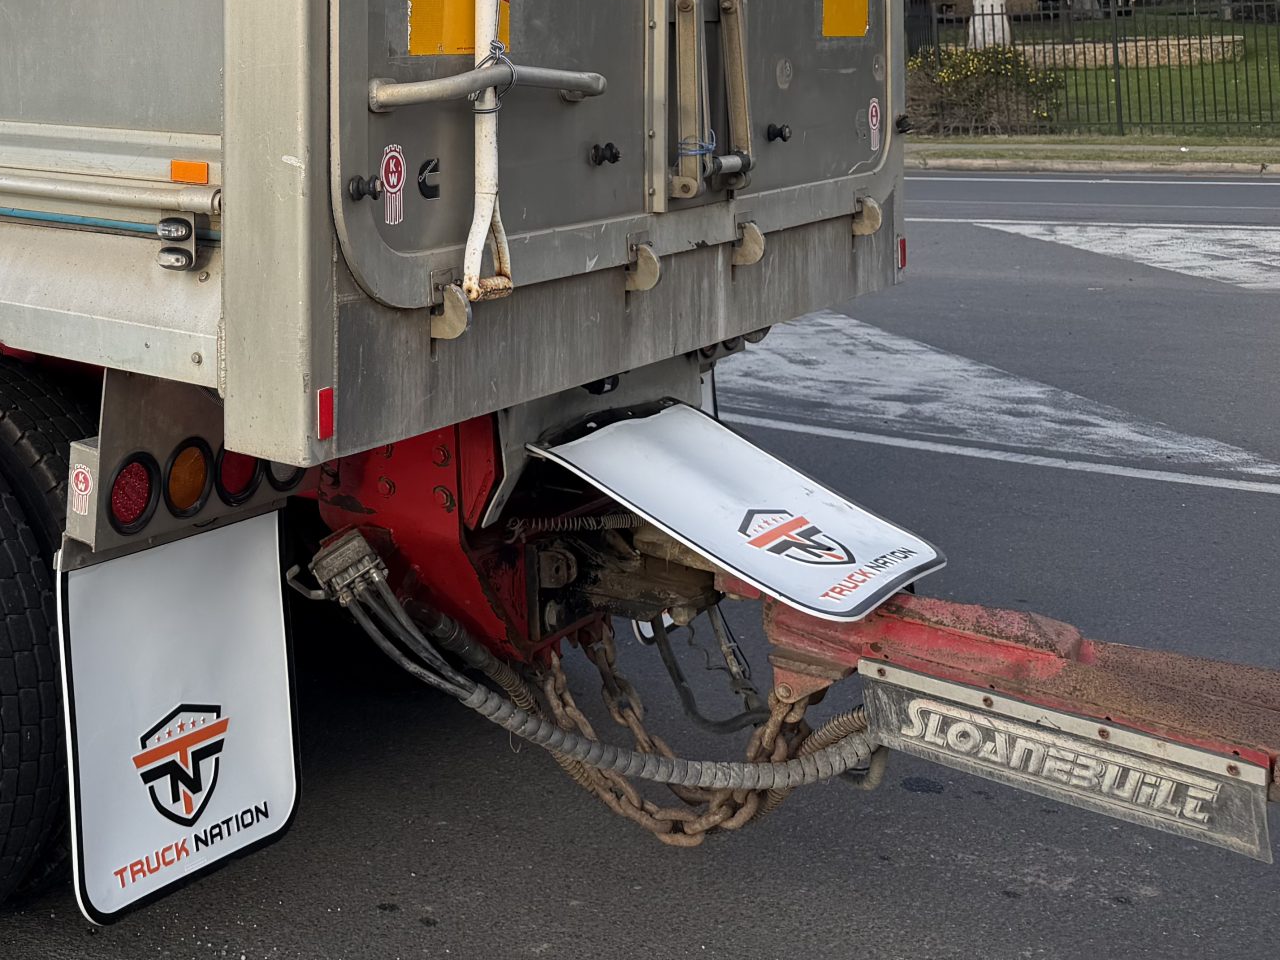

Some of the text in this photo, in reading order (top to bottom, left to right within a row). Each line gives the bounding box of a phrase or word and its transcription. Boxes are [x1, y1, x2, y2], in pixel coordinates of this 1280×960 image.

[819, 546, 919, 603] TRUCK NATION
[113, 800, 270, 889] TRUCK NATION
